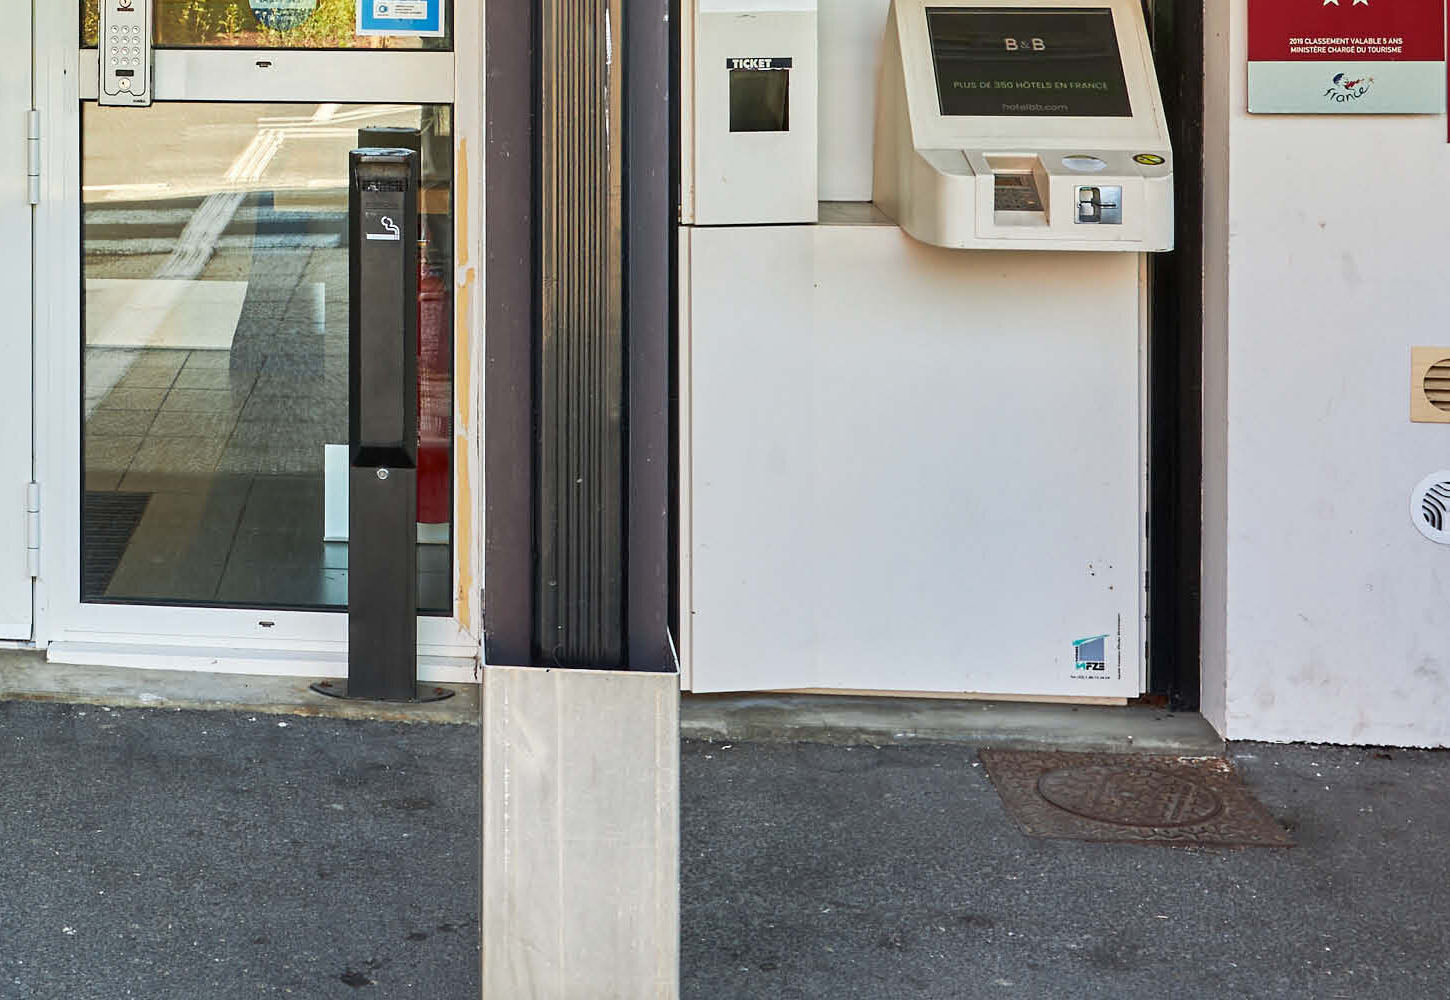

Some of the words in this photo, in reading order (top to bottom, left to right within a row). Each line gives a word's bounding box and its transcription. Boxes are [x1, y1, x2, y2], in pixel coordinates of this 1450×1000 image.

[1005, 38, 1046, 51] B&B
[1290, 46, 1327, 54] MINISTÈRE
[1327, 46, 1355, 54] CHARGÉ
[1356, 46, 1367, 54] DU
[1367, 46, 1402, 54] TOURISME
[732, 58, 772, 69] TICKET
[953, 80, 977, 89] PLUS
[979, 80, 992, 89] DE
[1054, 80, 1068, 89] EN
[1069, 80, 1108, 89] FRANCE
